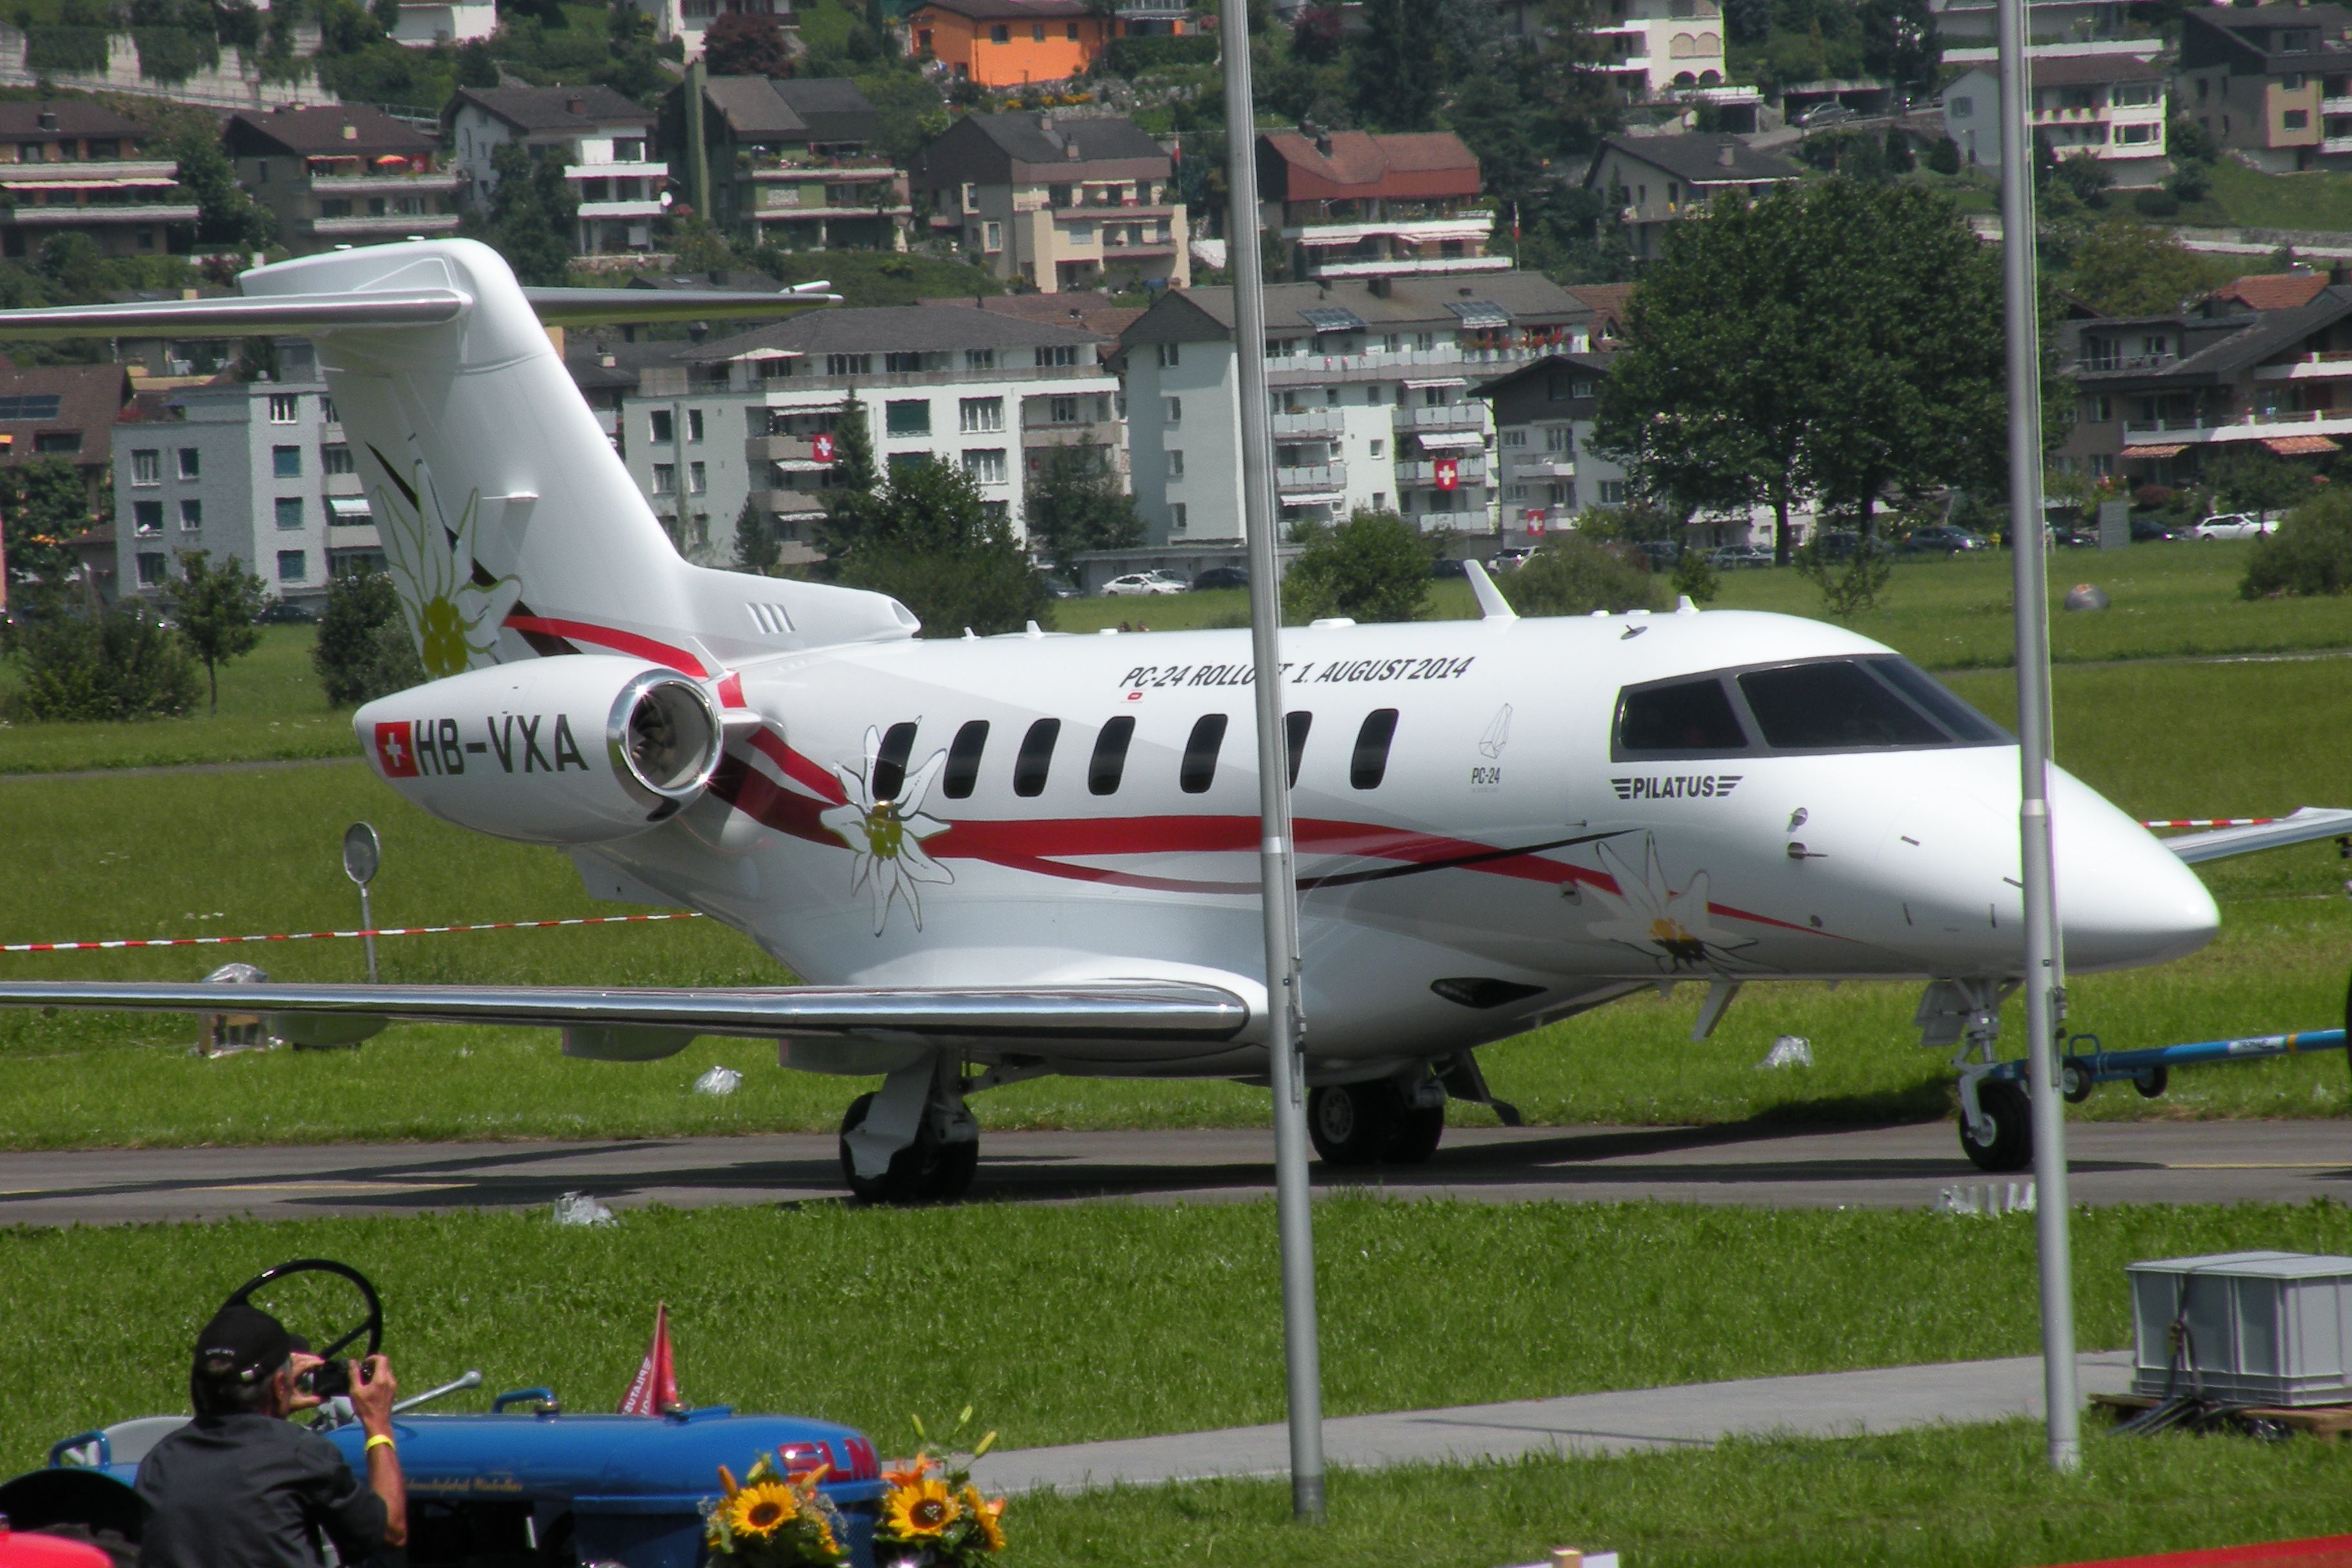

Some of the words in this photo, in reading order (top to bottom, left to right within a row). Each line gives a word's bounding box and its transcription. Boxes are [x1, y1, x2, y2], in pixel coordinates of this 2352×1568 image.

[1119, 666, 1192, 687] PC-24
[1187, 664, 1294, 687] ROLLOT
[1291, 662, 1315, 683] 1.
[1314, 659, 1417, 683] AUGUST
[1406, 656, 1476, 680] 2014
[415, 714, 590, 776] HB-VXA
[1471, 767, 1500, 784] PC-24
[1632, 775, 1716, 799] PILATUS
[778, 1435, 879, 1482] SLM
